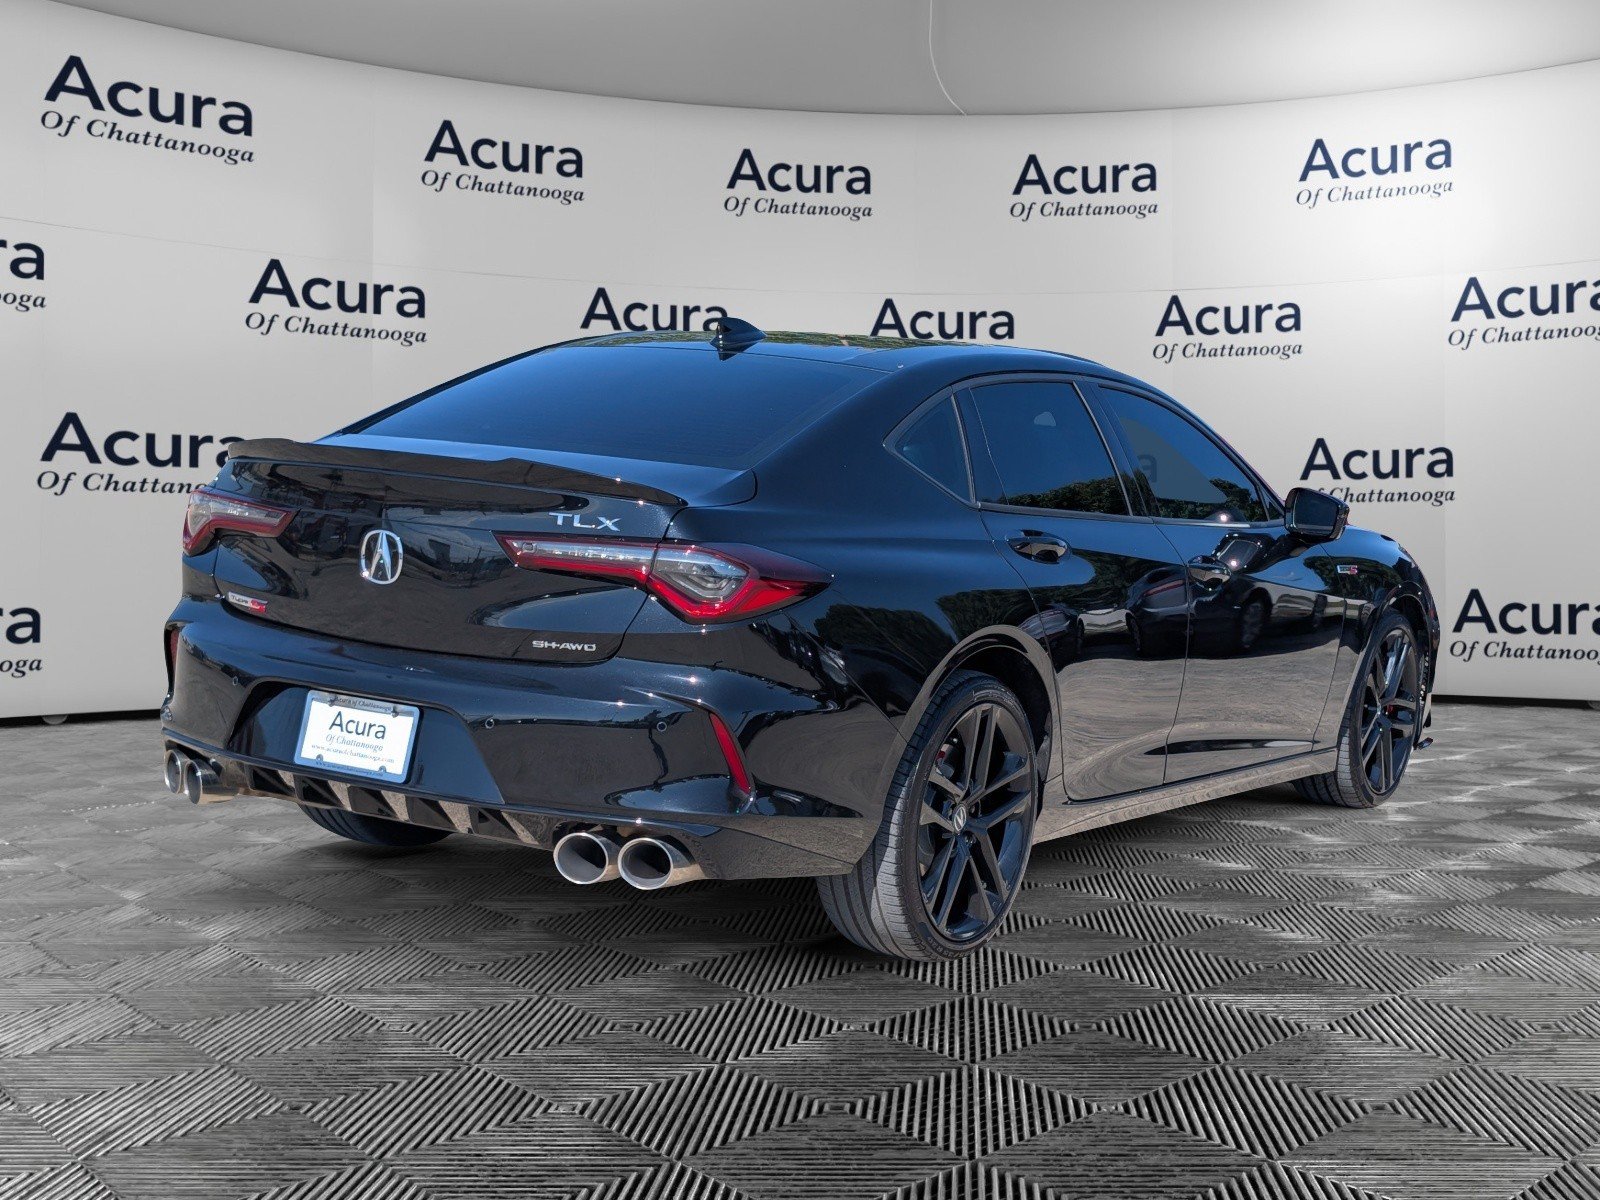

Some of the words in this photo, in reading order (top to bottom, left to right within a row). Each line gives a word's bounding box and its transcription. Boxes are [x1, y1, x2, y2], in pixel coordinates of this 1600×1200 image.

[43, 54, 254, 138] Acura
[40, 110, 82, 138] Of
[86, 118, 255, 166] Chattanooga
[423, 119, 585, 179] Acura
[726, 148, 872, 196] Acura
[1011, 153, 1157, 196] Acura
[1298, 137, 1452, 183] Acura
[420, 169, 452, 193] Of
[454, 173, 586, 206] Chattanooga
[1295, 188, 1325, 208] Of
[1327, 181, 1453, 206] Chattanooga
[723, 195, 751, 218] Of
[753, 197, 873, 222] Chattanooga
[1009, 201, 1037, 223] Of
[1039, 201, 1159, 219] Chattanooga
[247, 257, 427, 319] Acura
[244, 311, 281, 337] Of
[283, 315, 428, 347] Chattanooga
[869, 297, 1015, 341] Acura
[1154, 294, 1302, 337] Acura
[1151, 341, 1181, 364] Of
[1183, 342, 1304, 363] Chattanooga
[1447, 328, 1478, 351] Of
[1300, 437, 1454, 481] Acura
[36, 470, 77, 497] Of
[548, 511, 622, 532] TLX
[531, 639, 597, 652] SH-AWD
[1449, 640, 1479, 663] Of
[329, 710, 387, 739] Acura
[325, 733, 335, 746] Of
[336, 735, 384, 754] Chattanooga
